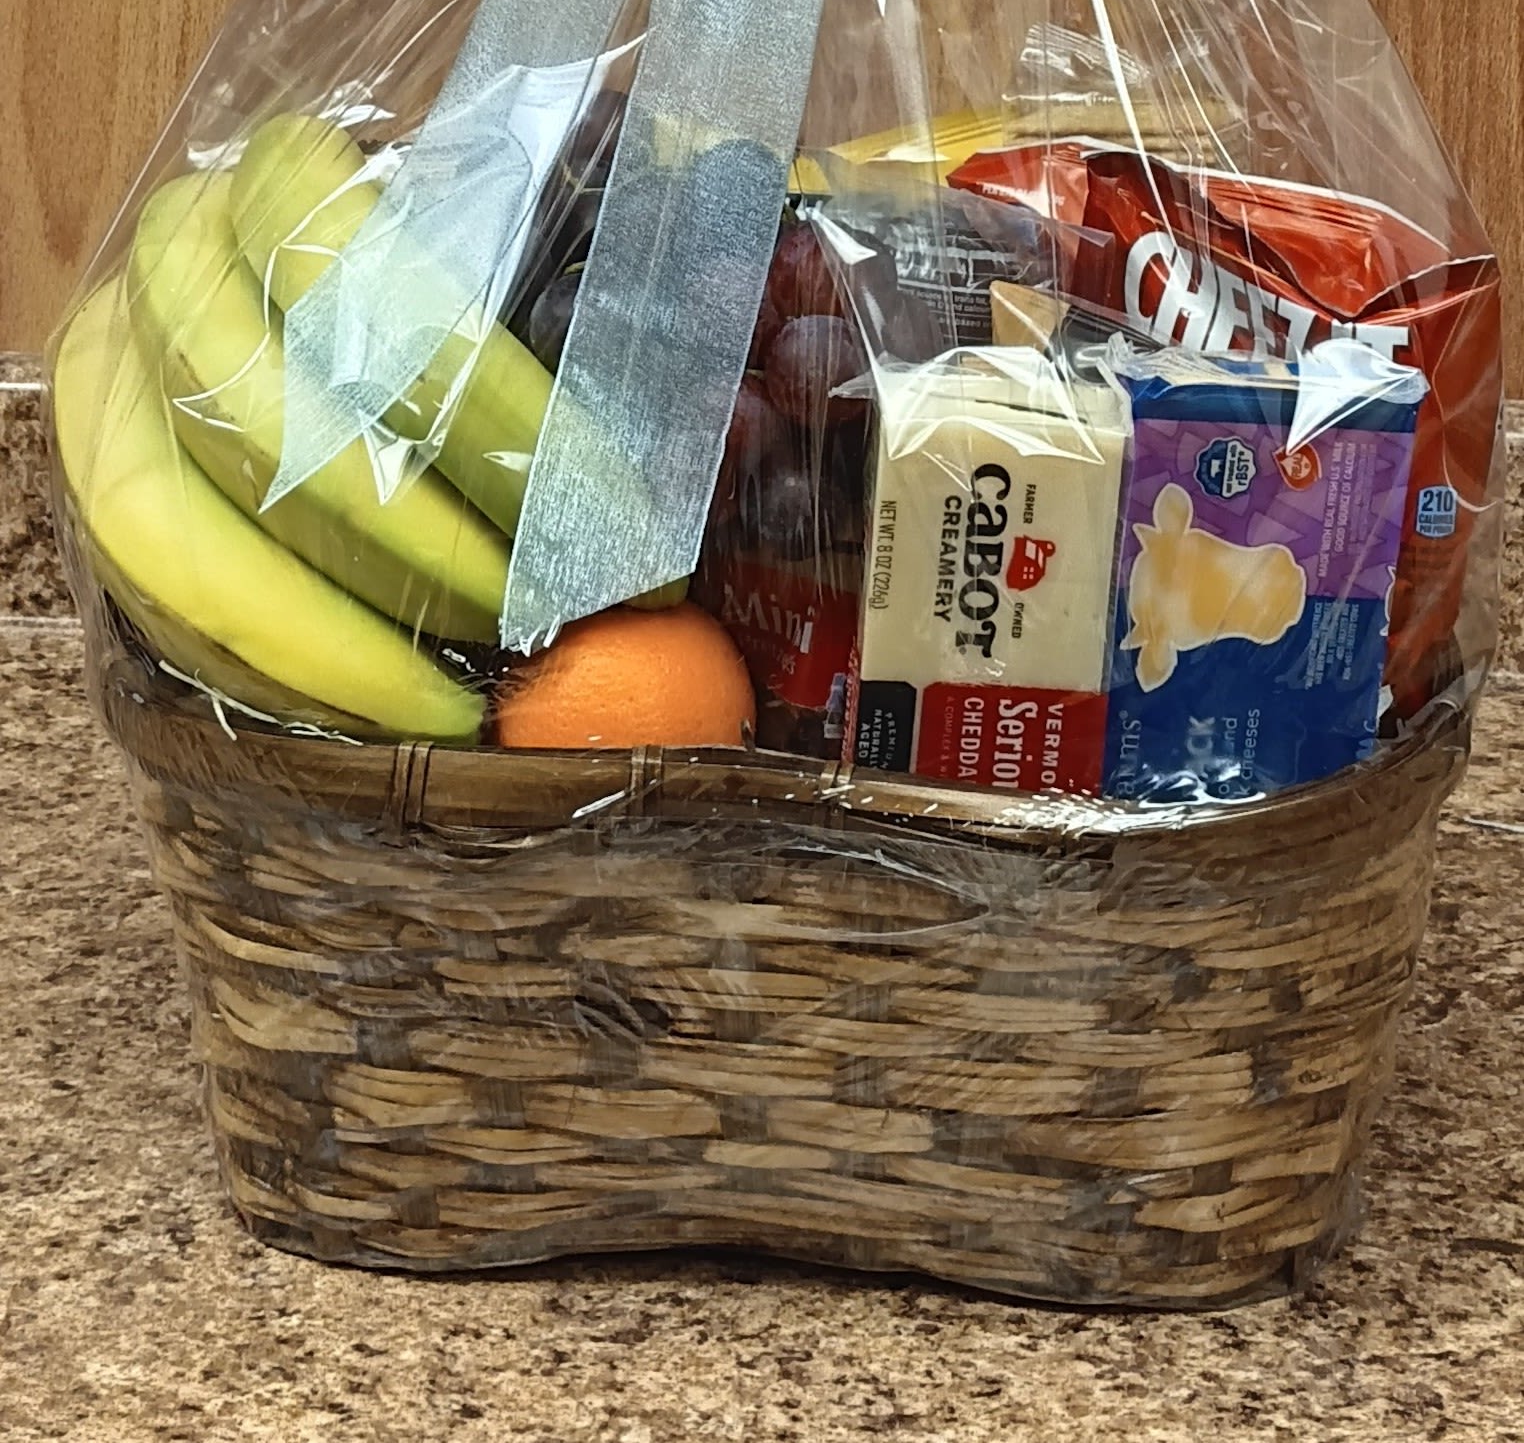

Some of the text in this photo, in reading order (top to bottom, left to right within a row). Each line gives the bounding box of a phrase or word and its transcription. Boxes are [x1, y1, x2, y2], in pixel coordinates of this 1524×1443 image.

[1421, 489, 1454, 512] 210
[869, 500, 897, 610] NET WT. 8 OZ (226g)
[934, 495, 963, 623] CREAMERY
[1012, 483, 1037, 639] FARMER OWNED
[858, 723, 871, 759] AGED
[957, 697, 984, 783] CHEDDA
[1040, 703, 1065, 791] VERMO
[1116, 718, 1142, 795] arms
